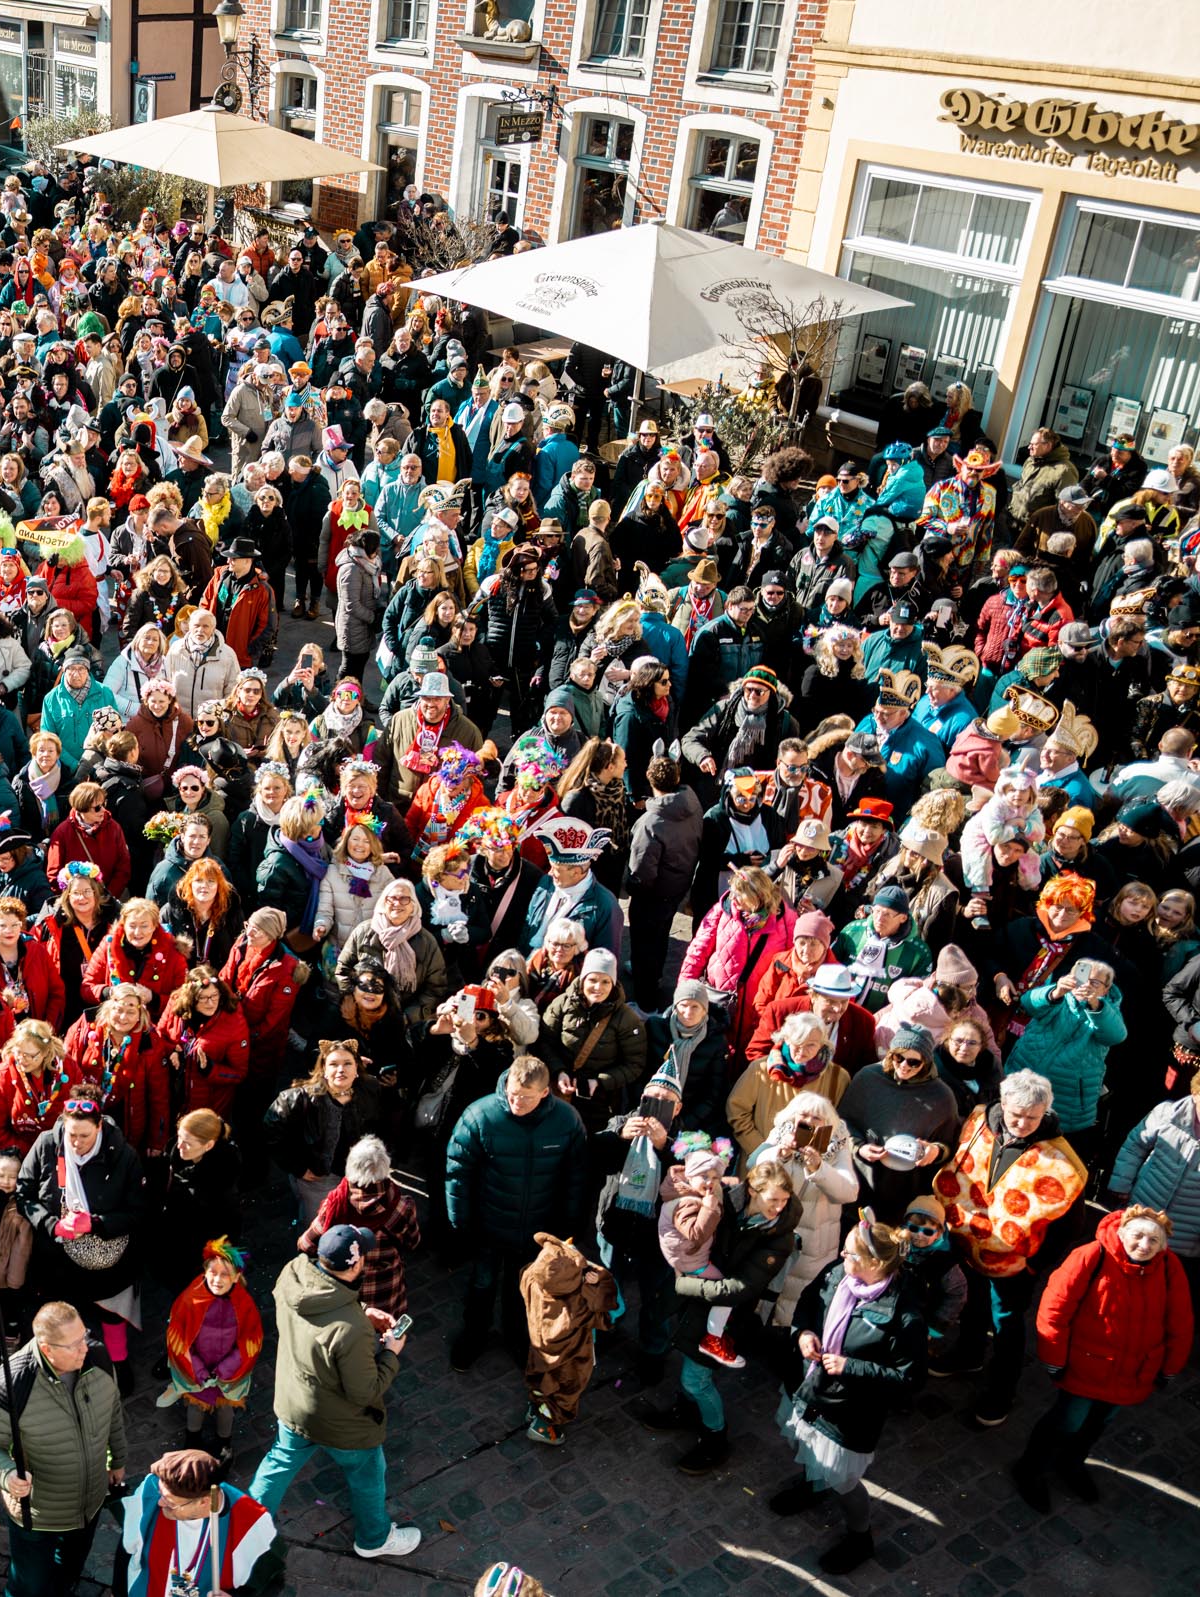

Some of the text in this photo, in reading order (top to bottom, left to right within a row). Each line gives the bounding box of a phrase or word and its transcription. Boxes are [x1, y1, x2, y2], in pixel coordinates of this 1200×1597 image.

[63, 36, 91, 54] In Mezzo
[501, 116, 541, 127] IN MEZZO
[937, 88, 1200, 156] Die Glocke
[959, 132, 1180, 184] Warendorfer Tageblatt
[700, 278, 772, 303] Grevensteiner
